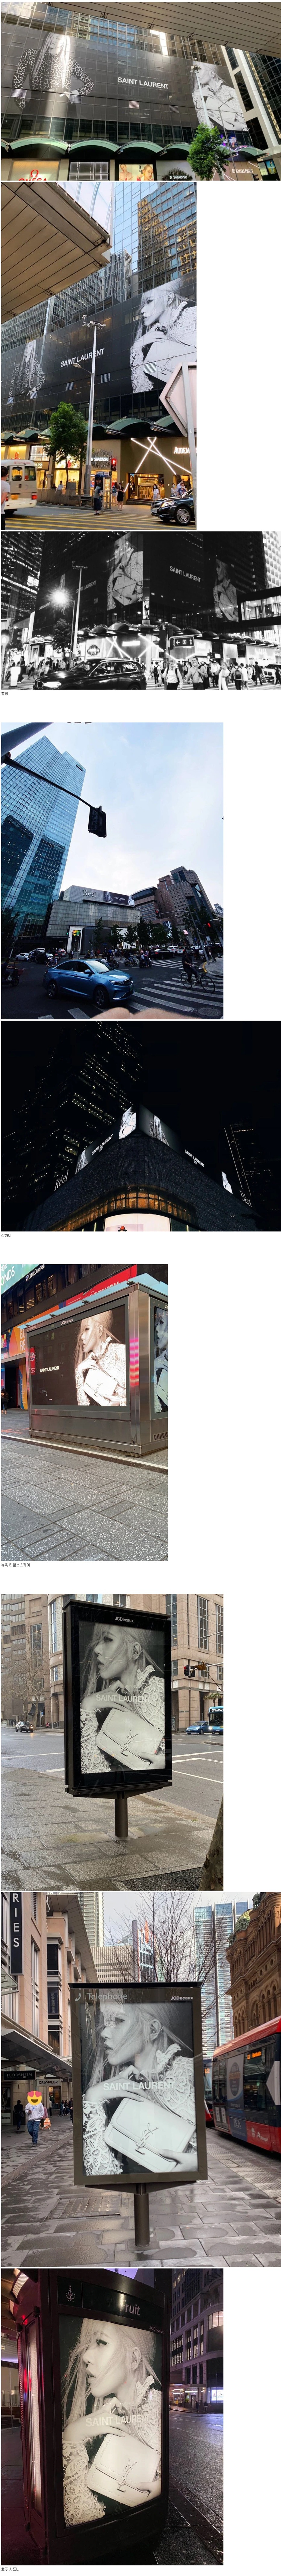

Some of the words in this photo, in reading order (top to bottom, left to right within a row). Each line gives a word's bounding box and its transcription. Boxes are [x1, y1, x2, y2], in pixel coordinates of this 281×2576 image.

[139, 80, 169, 89] LAURENT
[61, 357, 76, 367] SAINT
[170, 566, 182, 575] SAINT
[183, 571, 200, 582] LAURENT
[84, 580, 96, 590] LAURENT
[82, 889, 97, 897] Réel
[99, 1134, 113, 1148] LAURENT
[193, 1156, 204, 1167] LAURENT
[54, 1169, 69, 1191] Réel
[86, 1992, 127, 2002] Telephone
[103, 2082, 130, 2090] SAINT
[133, 2081, 175, 2090] LAURENT
[119, 2299, 140, 2316] Fruit
[86, 2417, 113, 2427] SAINT
[115, 2415, 149, 2424] LAURENT
